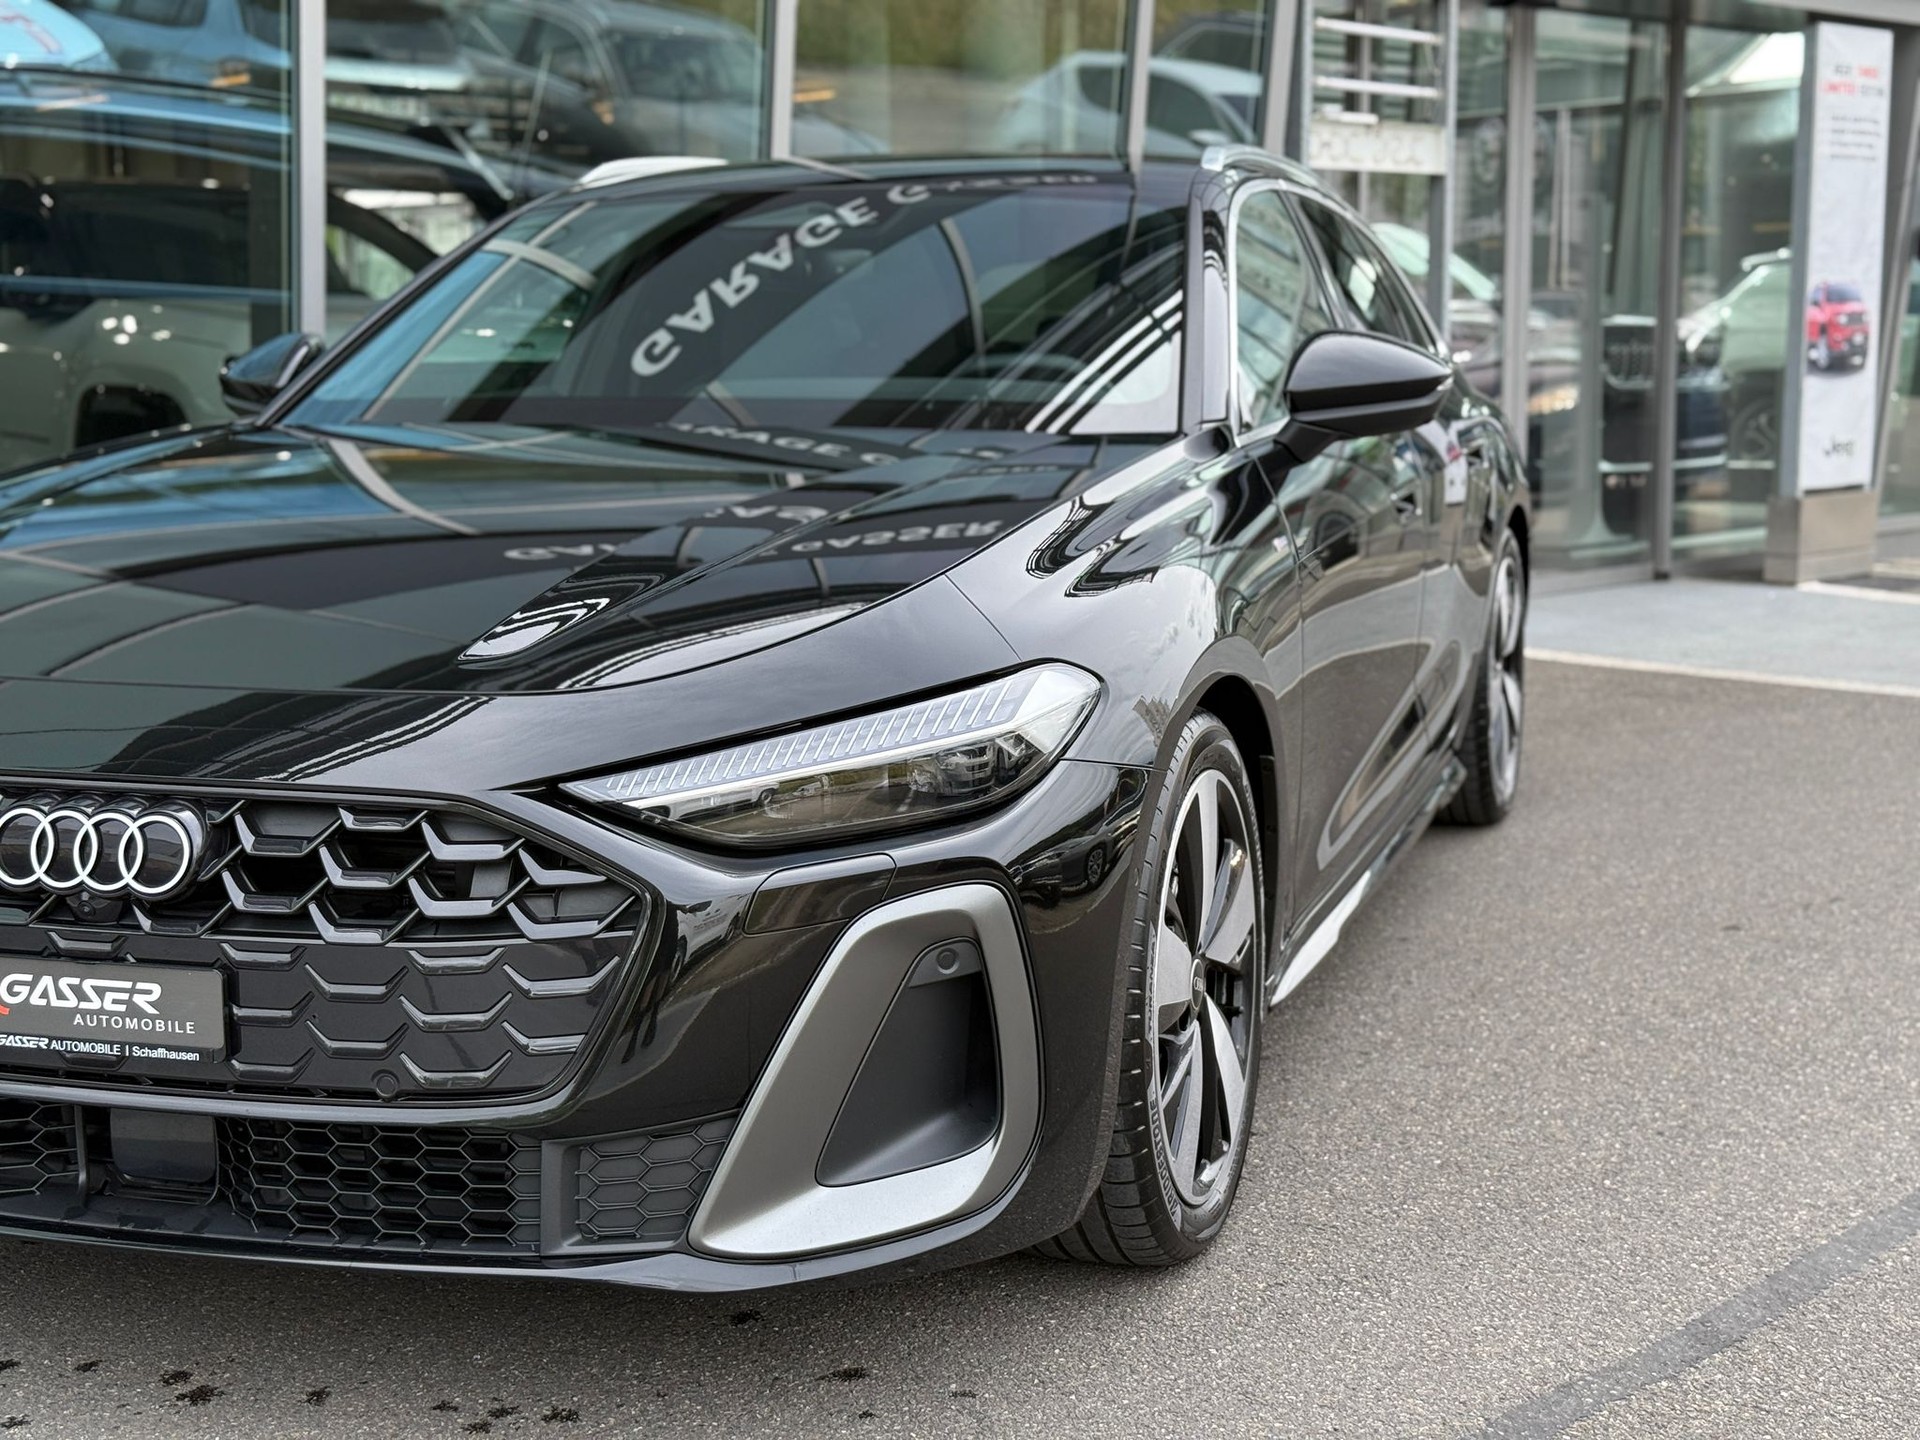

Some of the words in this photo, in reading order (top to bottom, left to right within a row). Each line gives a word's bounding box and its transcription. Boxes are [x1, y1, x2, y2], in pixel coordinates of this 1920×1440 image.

[0, 973, 162, 1015] GASSER
[73, 1013, 196, 1034] AUTOMOBILE
[0, 1034, 49, 1049] GASSER
[50, 1039, 121, 1056] AUTOMOBILE
[132, 1045, 200, 1061] Schaffhausen
